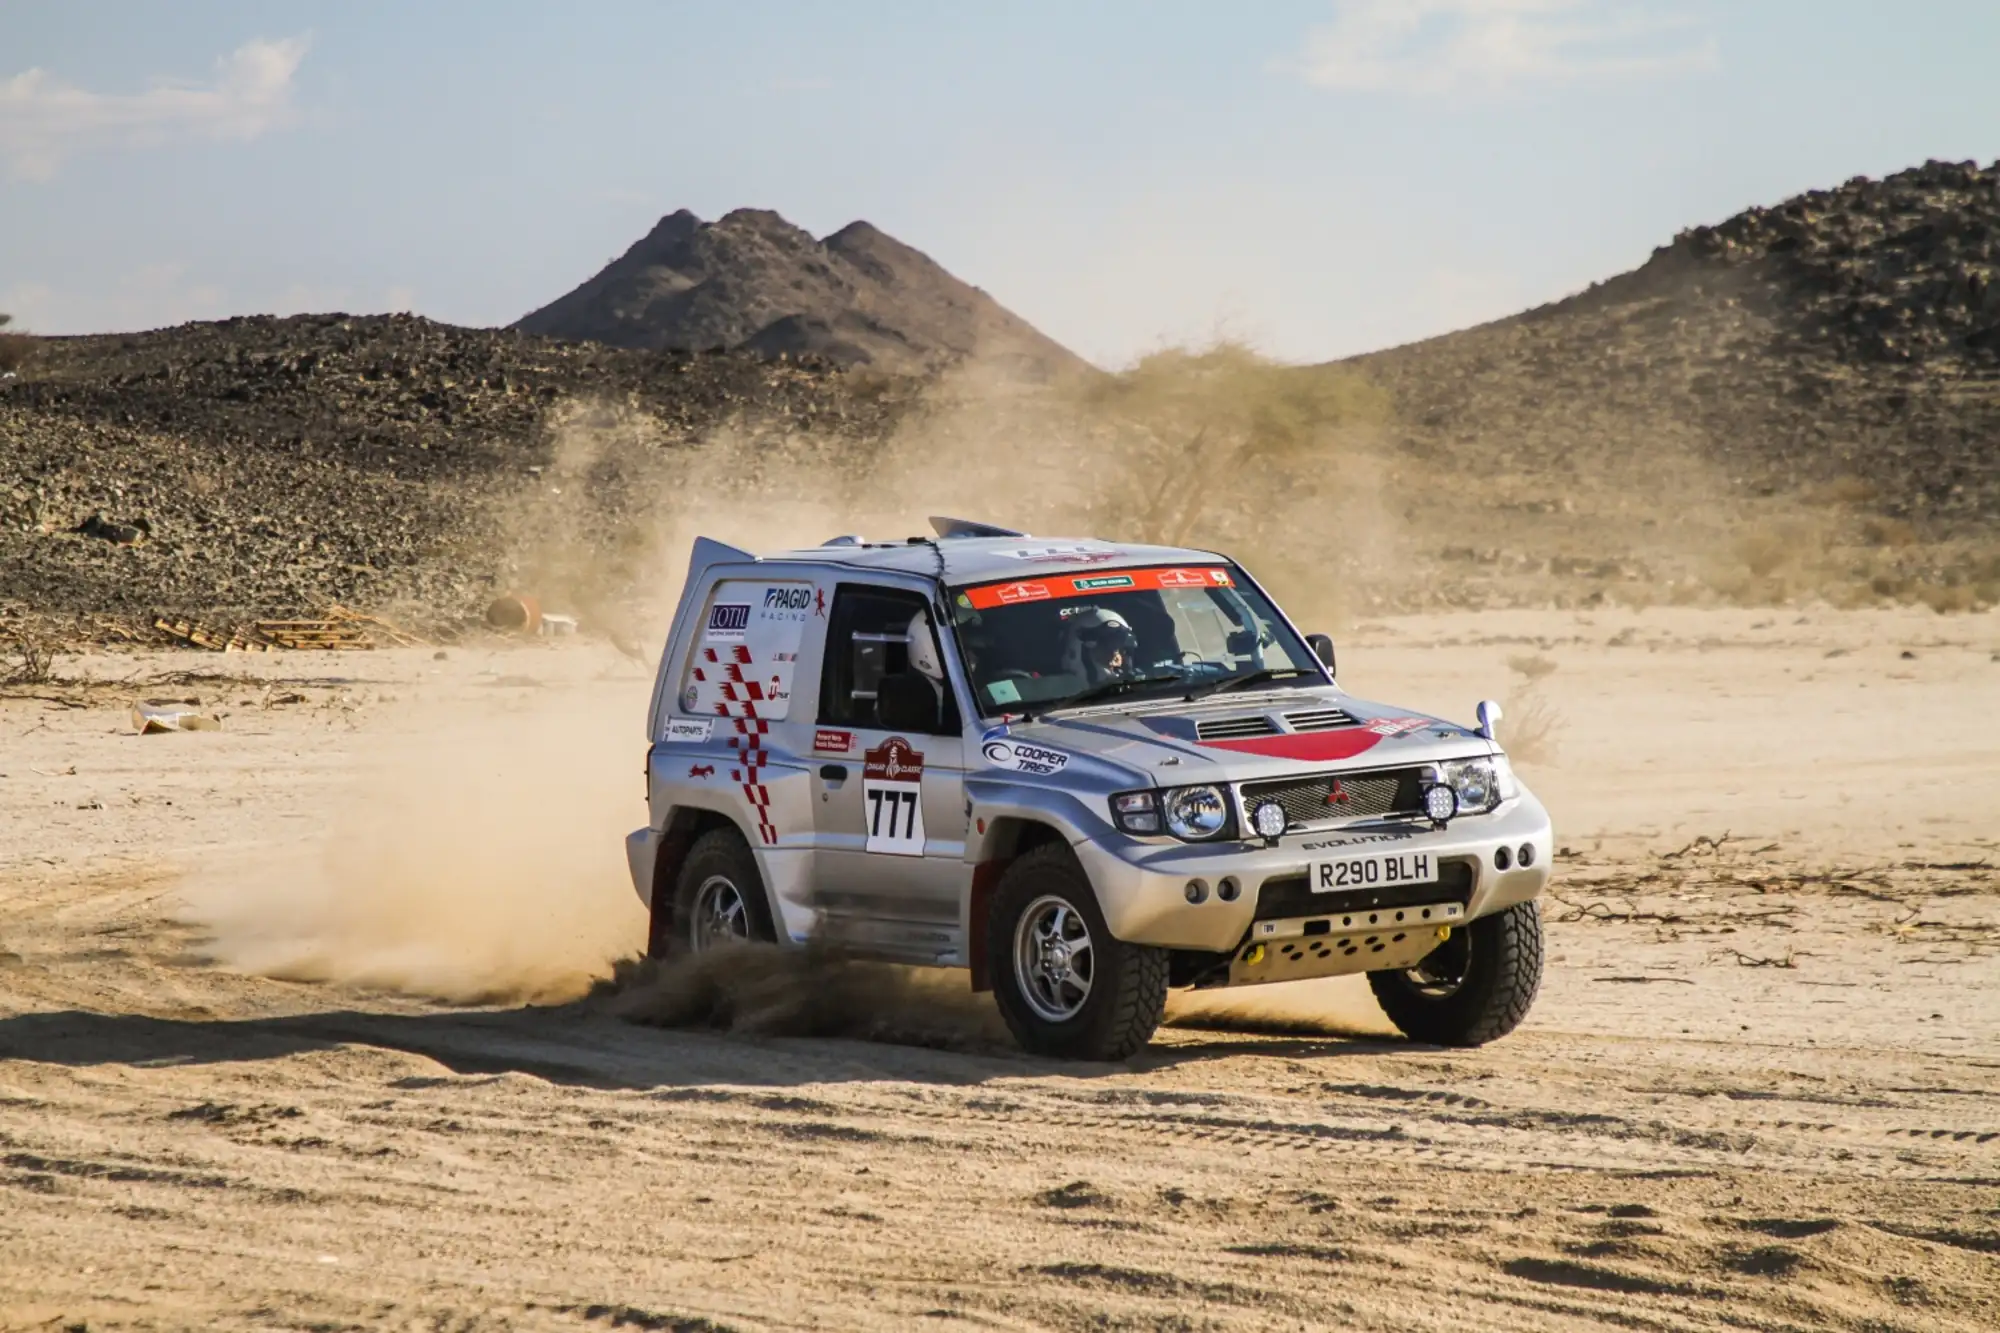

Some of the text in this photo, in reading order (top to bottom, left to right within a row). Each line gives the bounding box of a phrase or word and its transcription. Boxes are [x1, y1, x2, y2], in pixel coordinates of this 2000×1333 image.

[775, 588, 811, 609] PAGID
[761, 611, 806, 621] RACING
[672, 725, 703, 735] AUTOPARTS
[1014, 745, 1068, 767] COOPER
[1017, 760, 1055, 774] TIRES
[868, 789, 918, 839] 777
[1302, 833, 1412, 850] EVOLUTION
[1320, 855, 1429, 888] R290 BLH
